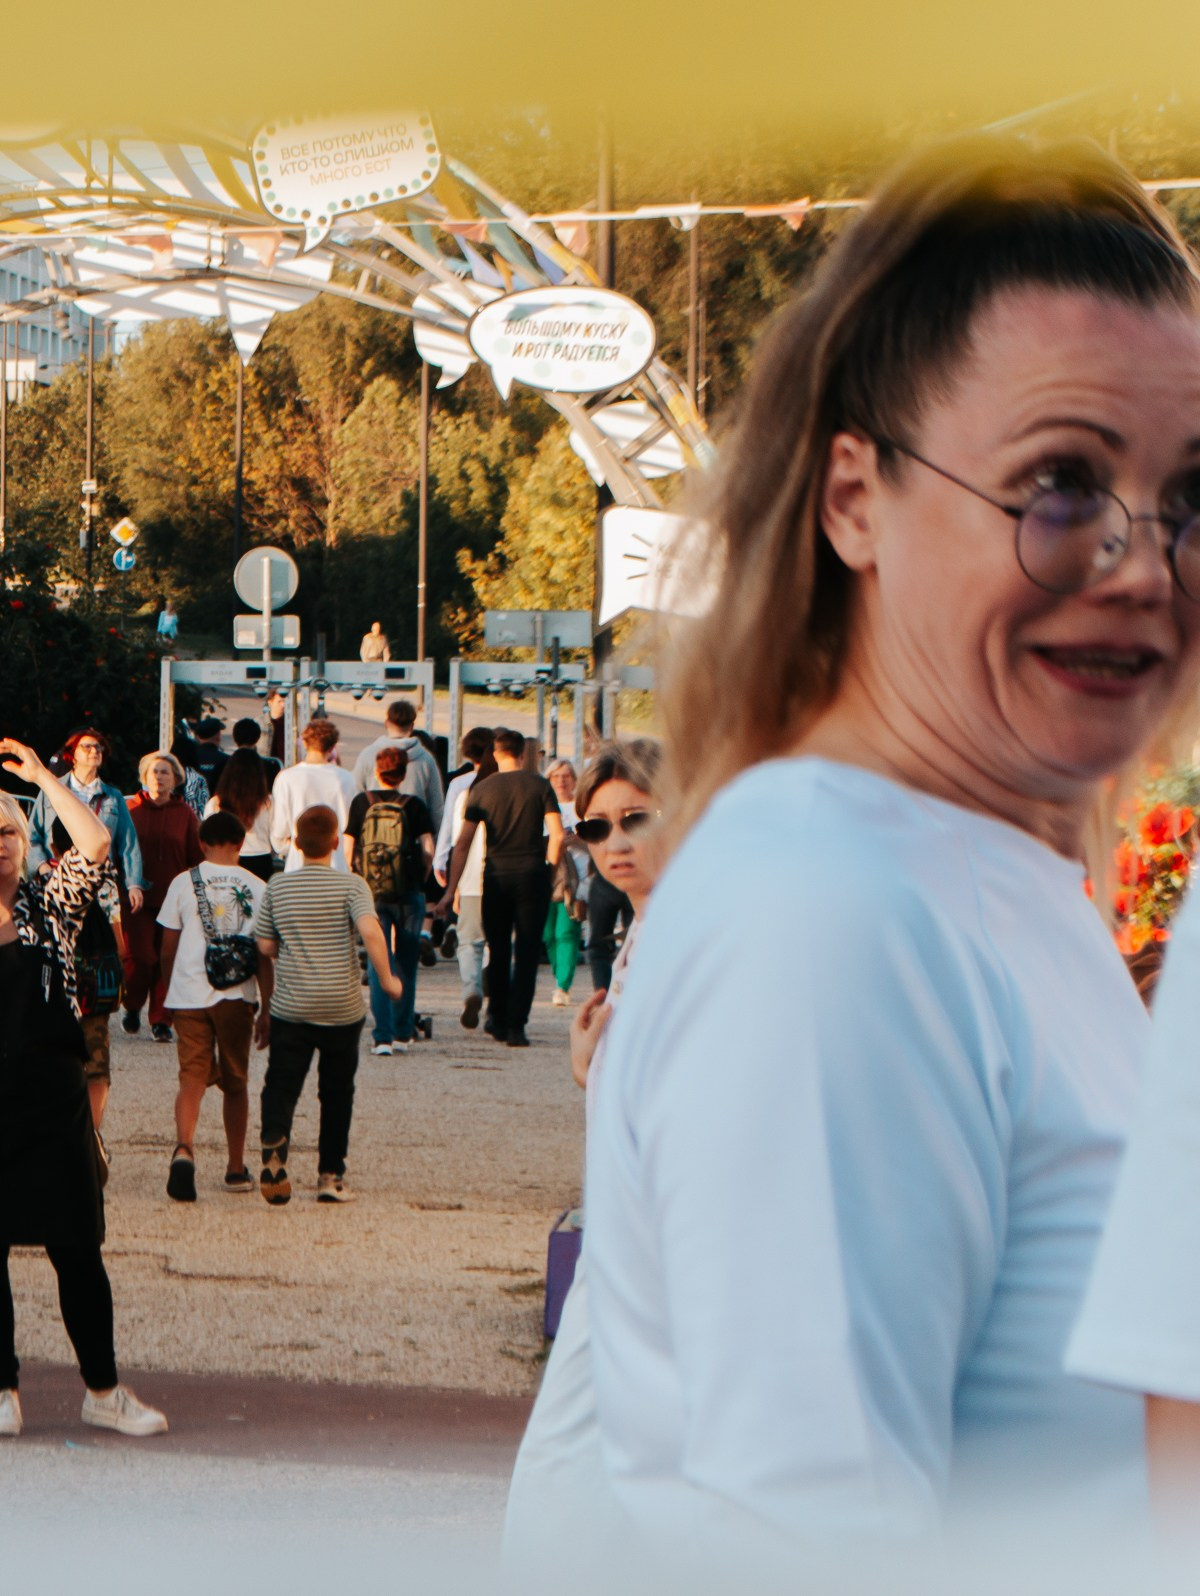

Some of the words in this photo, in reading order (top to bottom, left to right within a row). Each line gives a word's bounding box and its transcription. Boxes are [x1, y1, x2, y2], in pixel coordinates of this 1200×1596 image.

[280, 142, 310, 161] ВСЕ
[312, 128, 375, 153] ПОТОМУ
[376, 123, 408, 139] ЧТО
[279, 155, 331, 176] КТО-ТО
[333, 137, 415, 164] СЛИШКОМ
[309, 165, 362, 186] МНОГО
[365, 158, 393, 175] ЕСТ
[504, 318, 582, 338] БОЛЬШОМУ
[583, 321, 629, 340] КУСКУ
[512, 342, 523, 358] И
[524, 342, 552, 359] РОТ
[552, 343, 620, 362] РАДУЕТСЯ
